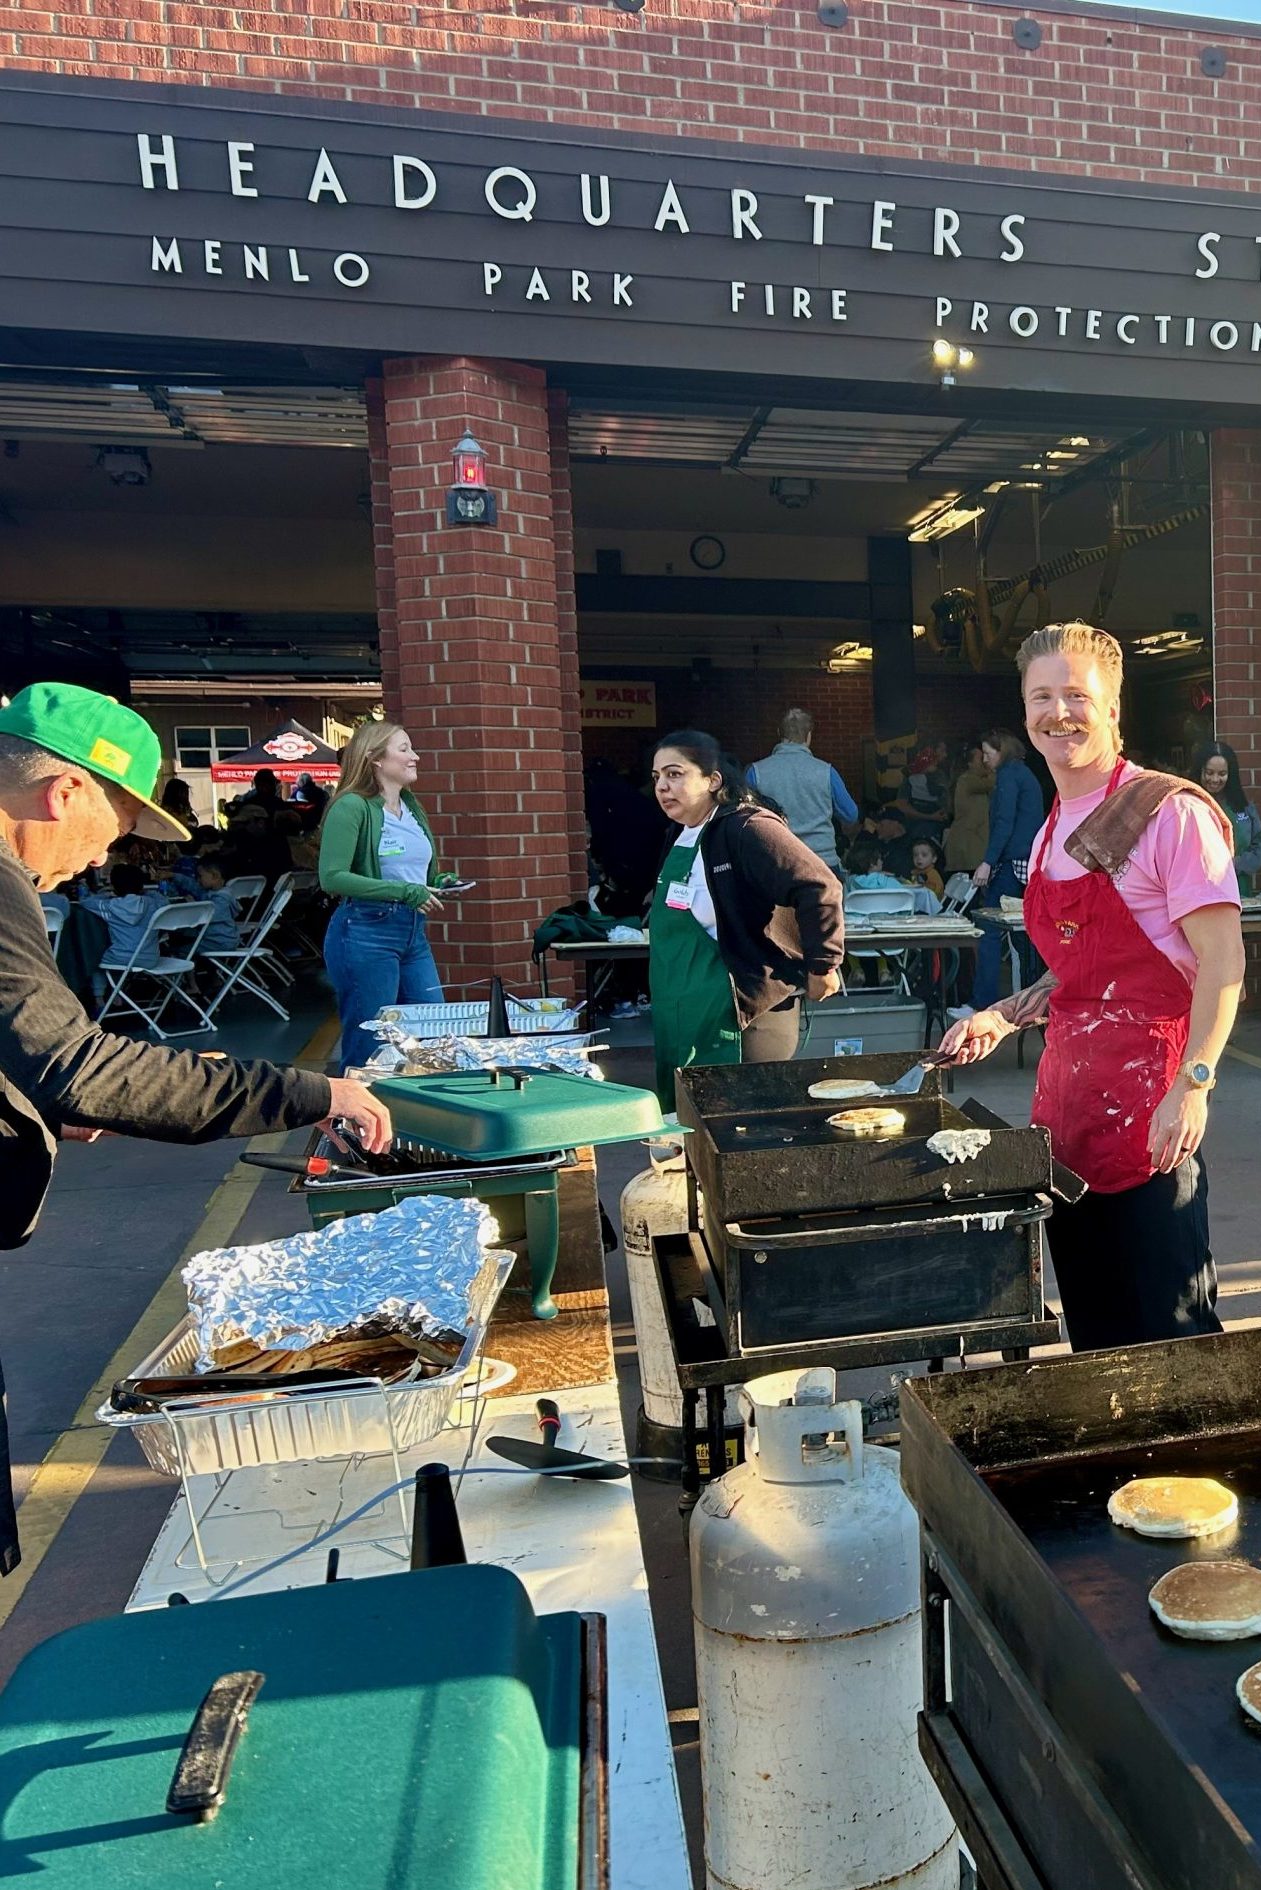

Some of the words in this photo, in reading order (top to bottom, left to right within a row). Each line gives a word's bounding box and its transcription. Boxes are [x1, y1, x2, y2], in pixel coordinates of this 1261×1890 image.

[136, 132, 1027, 264] HEADQUARTERS
[151, 235, 370, 289] MENLO
[483, 261, 635, 308] PARK
[730, 281, 849, 322] FIRE
[580, 707, 636, 720] ISTRICT
[595, 687, 653, 706] PARK
